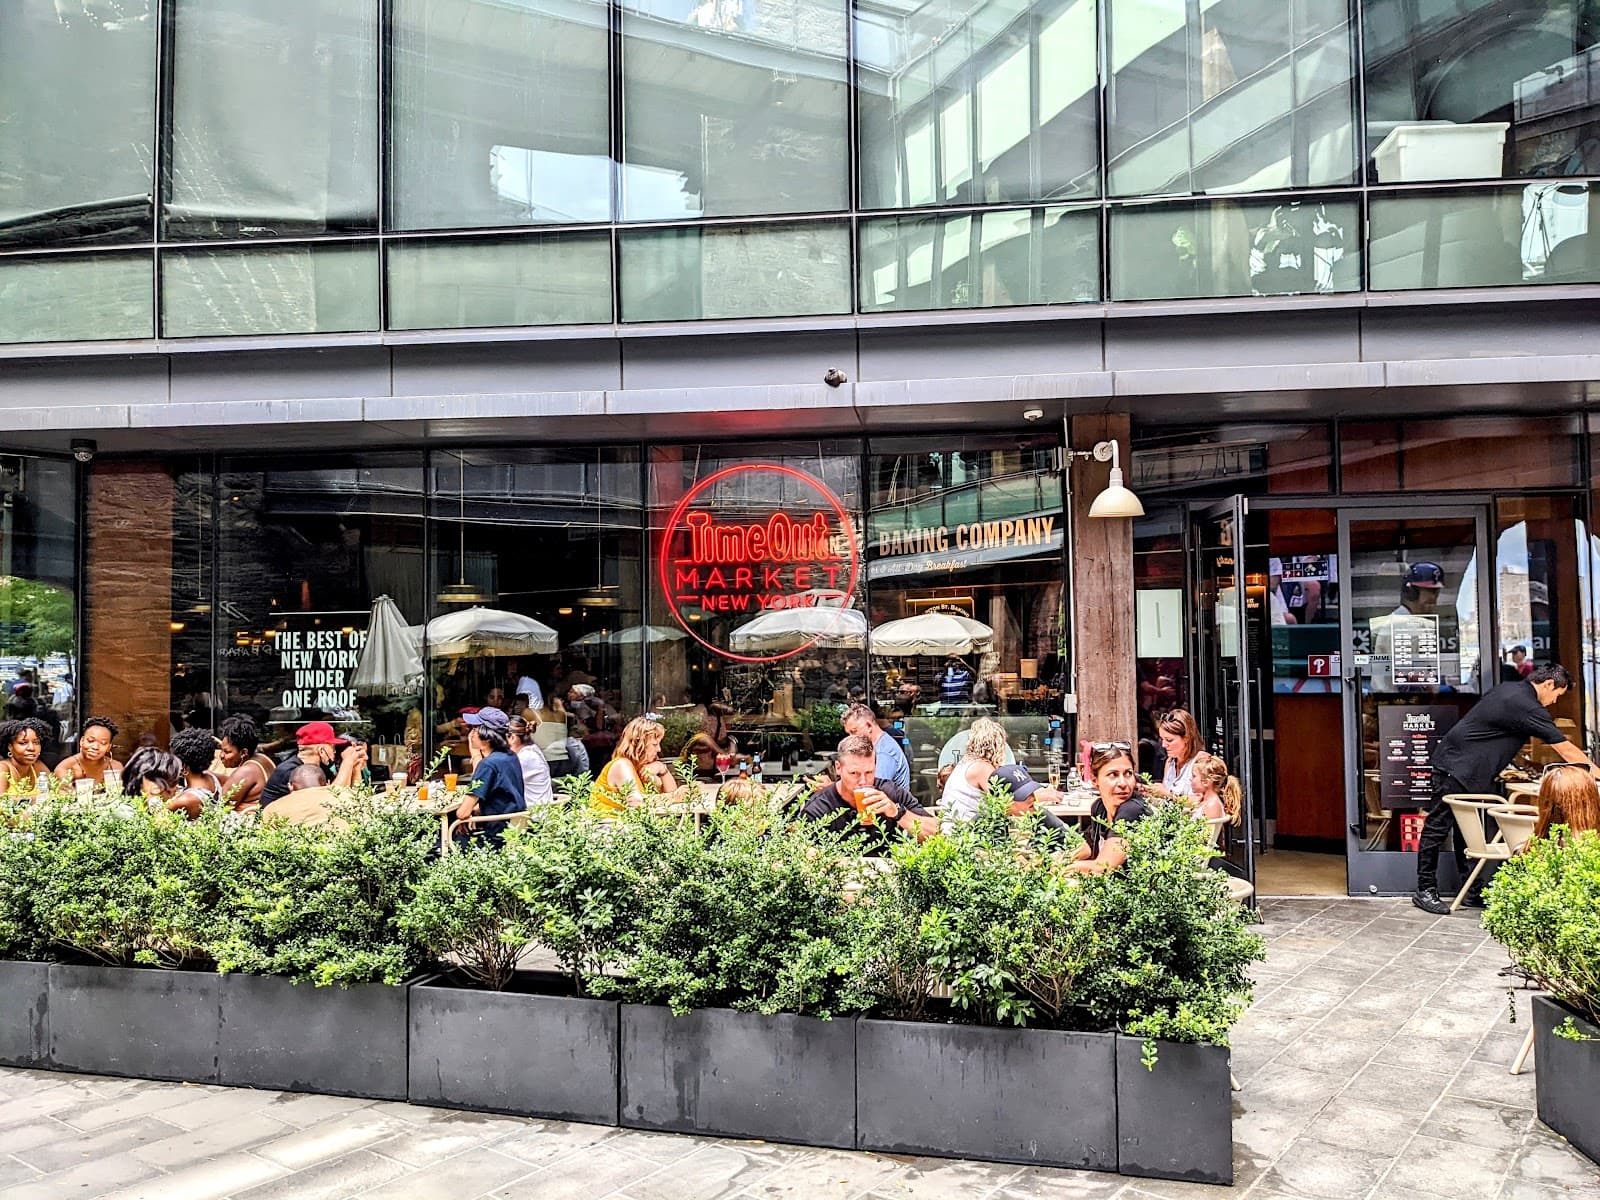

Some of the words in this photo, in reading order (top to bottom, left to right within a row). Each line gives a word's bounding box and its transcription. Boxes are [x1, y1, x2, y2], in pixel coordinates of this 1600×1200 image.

[879, 526, 949, 557] BAKING
[955, 516, 1055, 551] COMPANY
[926, 559, 968, 572] Breakfast
[675, 566, 841, 591] MARKET
[701, 594, 749, 612] NEW
[755, 593, 814, 611] YORK
[274, 631, 301, 650] THE
[306, 630, 343, 649] BEST
[348, 629, 367, 649] OF
[281, 650, 313, 670] NEW
[319, 649, 359, 669] YORK
[294, 669, 345, 689] UNDER
[282, 689, 313, 709] ONE
[317, 688, 358, 709] ROOF
